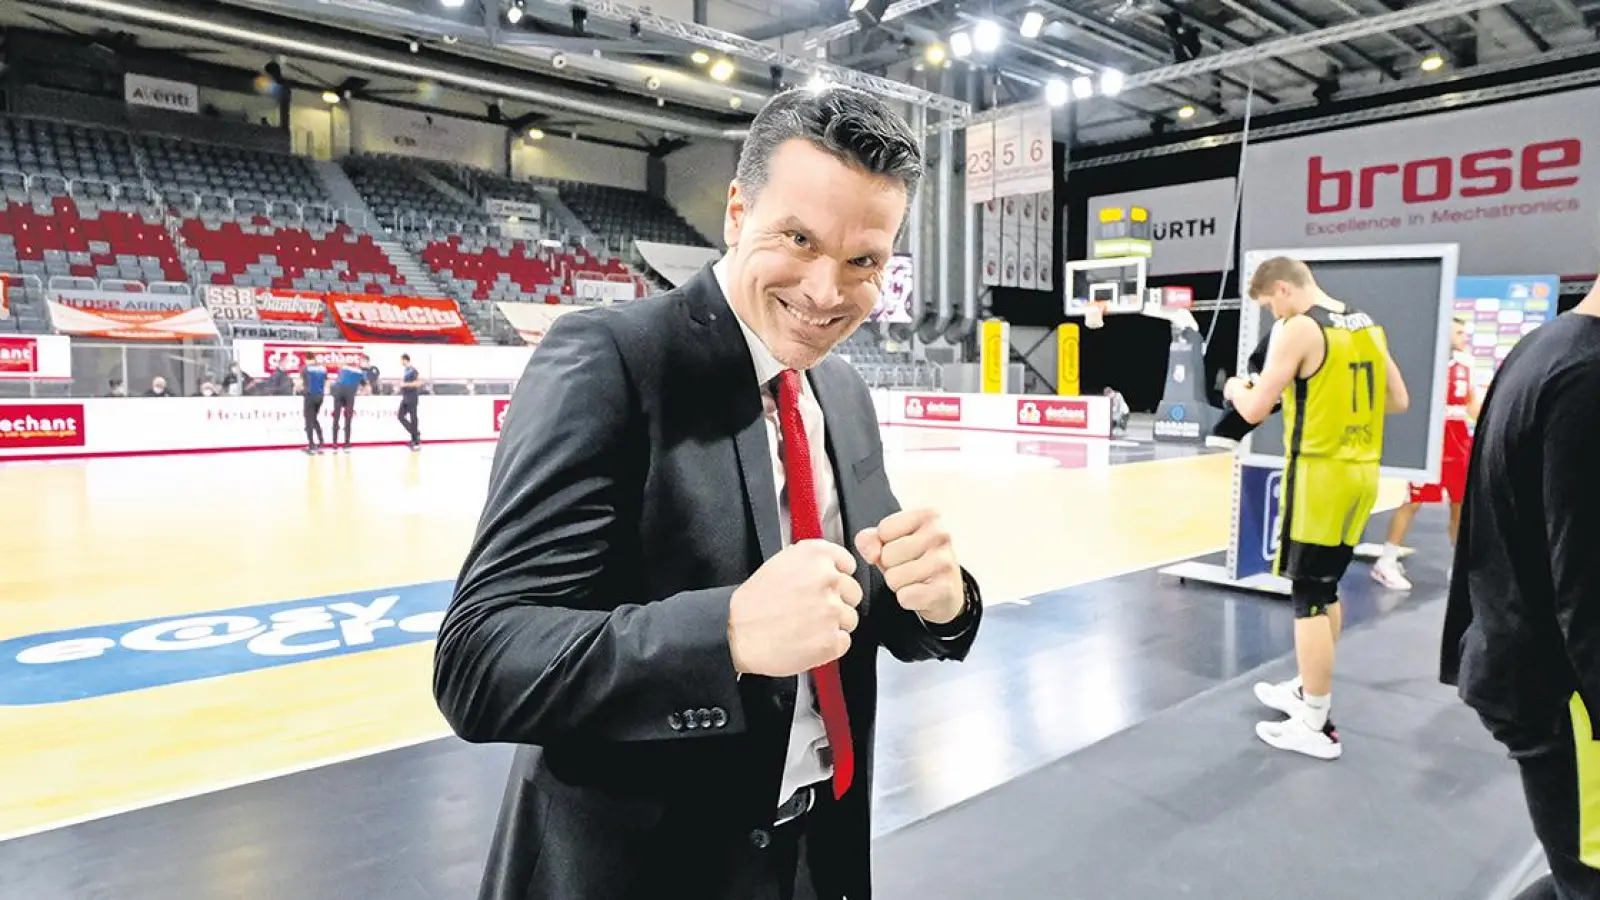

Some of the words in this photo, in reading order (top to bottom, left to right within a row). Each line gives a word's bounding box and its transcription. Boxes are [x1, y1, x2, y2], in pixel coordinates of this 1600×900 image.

[968, 150, 993, 174] 23
[1003, 142, 1015, 166] 5
[1030, 139, 1043, 162] 6
[1307, 138, 1581, 214] brose
[1153, 216, 1216, 240] ÜRTH
[1305, 215, 1401, 236] Excellence
[1408, 212, 1425, 226] in
[1430, 198, 1581, 225] Mechatronics
[212, 307, 253, 320] 2012
